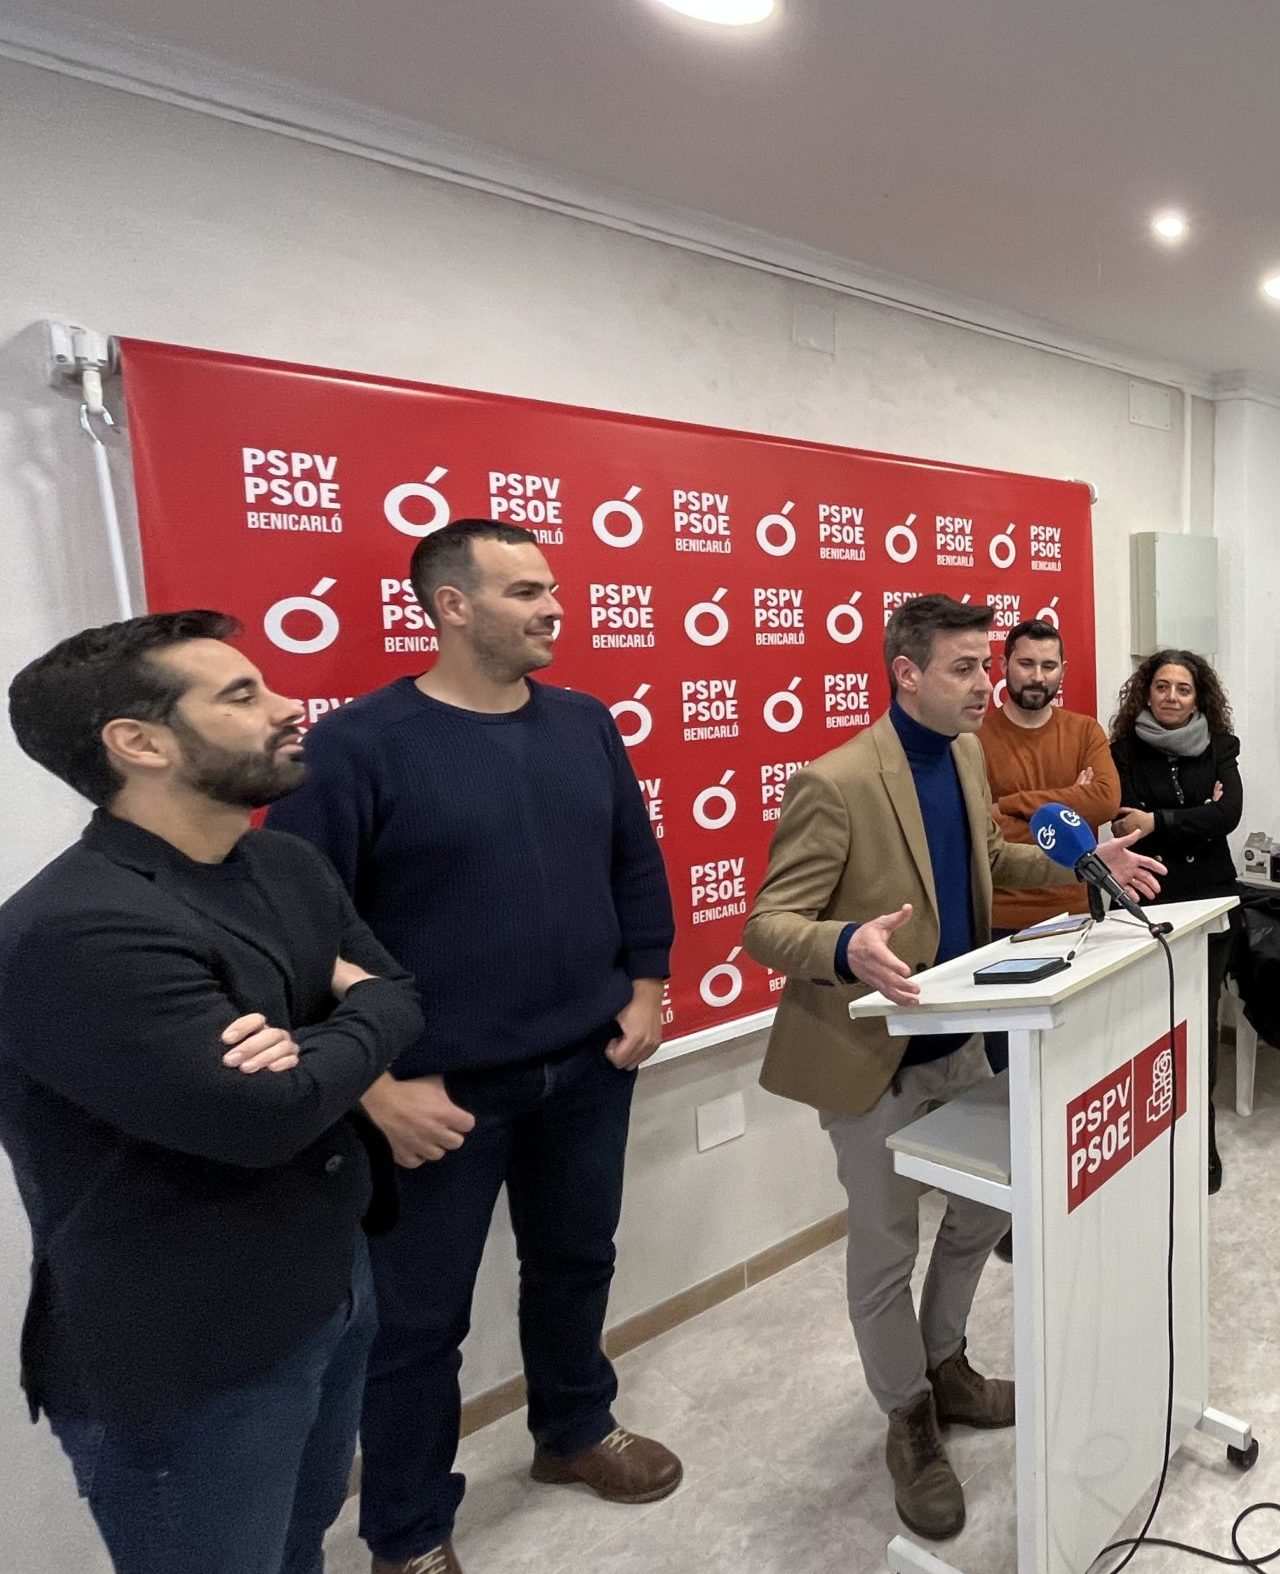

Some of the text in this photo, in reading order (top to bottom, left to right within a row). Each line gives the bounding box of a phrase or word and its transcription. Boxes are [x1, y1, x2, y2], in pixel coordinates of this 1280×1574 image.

[241, 447, 338, 481] PSPV
[244, 476, 342, 510] PSOE
[488, 471, 561, 500] PSPV
[489, 496, 563, 525] PSOE
[672, 489, 729, 514] PSPV
[246, 511, 343, 534] BENICARLÓ
[673, 511, 731, 536] PSOE
[818, 503, 864, 526] PSPV
[935, 515, 973, 535] PSPV
[819, 523, 865, 545] PSOE
[936, 533, 974, 553] PSOE
[1029, 524, 1062, 543] PSPV
[675, 537, 732, 555] BENICARLÓ
[819, 546, 866, 562] BENICARLÓ
[1030, 541, 1062, 559] PSOE
[936, 554, 975, 568] BENICARLÓ
[1030, 560, 1062, 572] BENICARLÓ
[380, 578, 418, 603] PS
[589, 583, 652, 606] PSPV
[753, 587, 803, 608] PSPV
[882, 591, 923, 609] PS
[986, 593, 1021, 611] PSPV
[382, 604, 436, 630] PS
[590, 606, 655, 629] PSOE
[754, 608, 805, 628] PSOE
[992, 610, 1021, 628] SOE
[384, 636, 440, 653] BENICA
[592, 630, 655, 649] BENICARLÓ
[755, 630, 805, 646] BENICARLÓ
[681, 679, 737, 701] PSPV
[824, 673, 869, 693] PSPV
[682, 699, 739, 723] PSOE
[825, 691, 870, 712] PSOE
[825, 711, 870, 729] BENICARLÓ
[683, 721, 739, 742] BENICARLÓ
[761, 783, 786, 805] PS
[690, 857, 744, 886] PSPV
[691, 876, 746, 907] PSOE
[692, 898, 747, 925] BENICARLÓ
[1071, 1076, 1131, 1146] PSPV
[1071, 1110, 1131, 1190] PSOE
